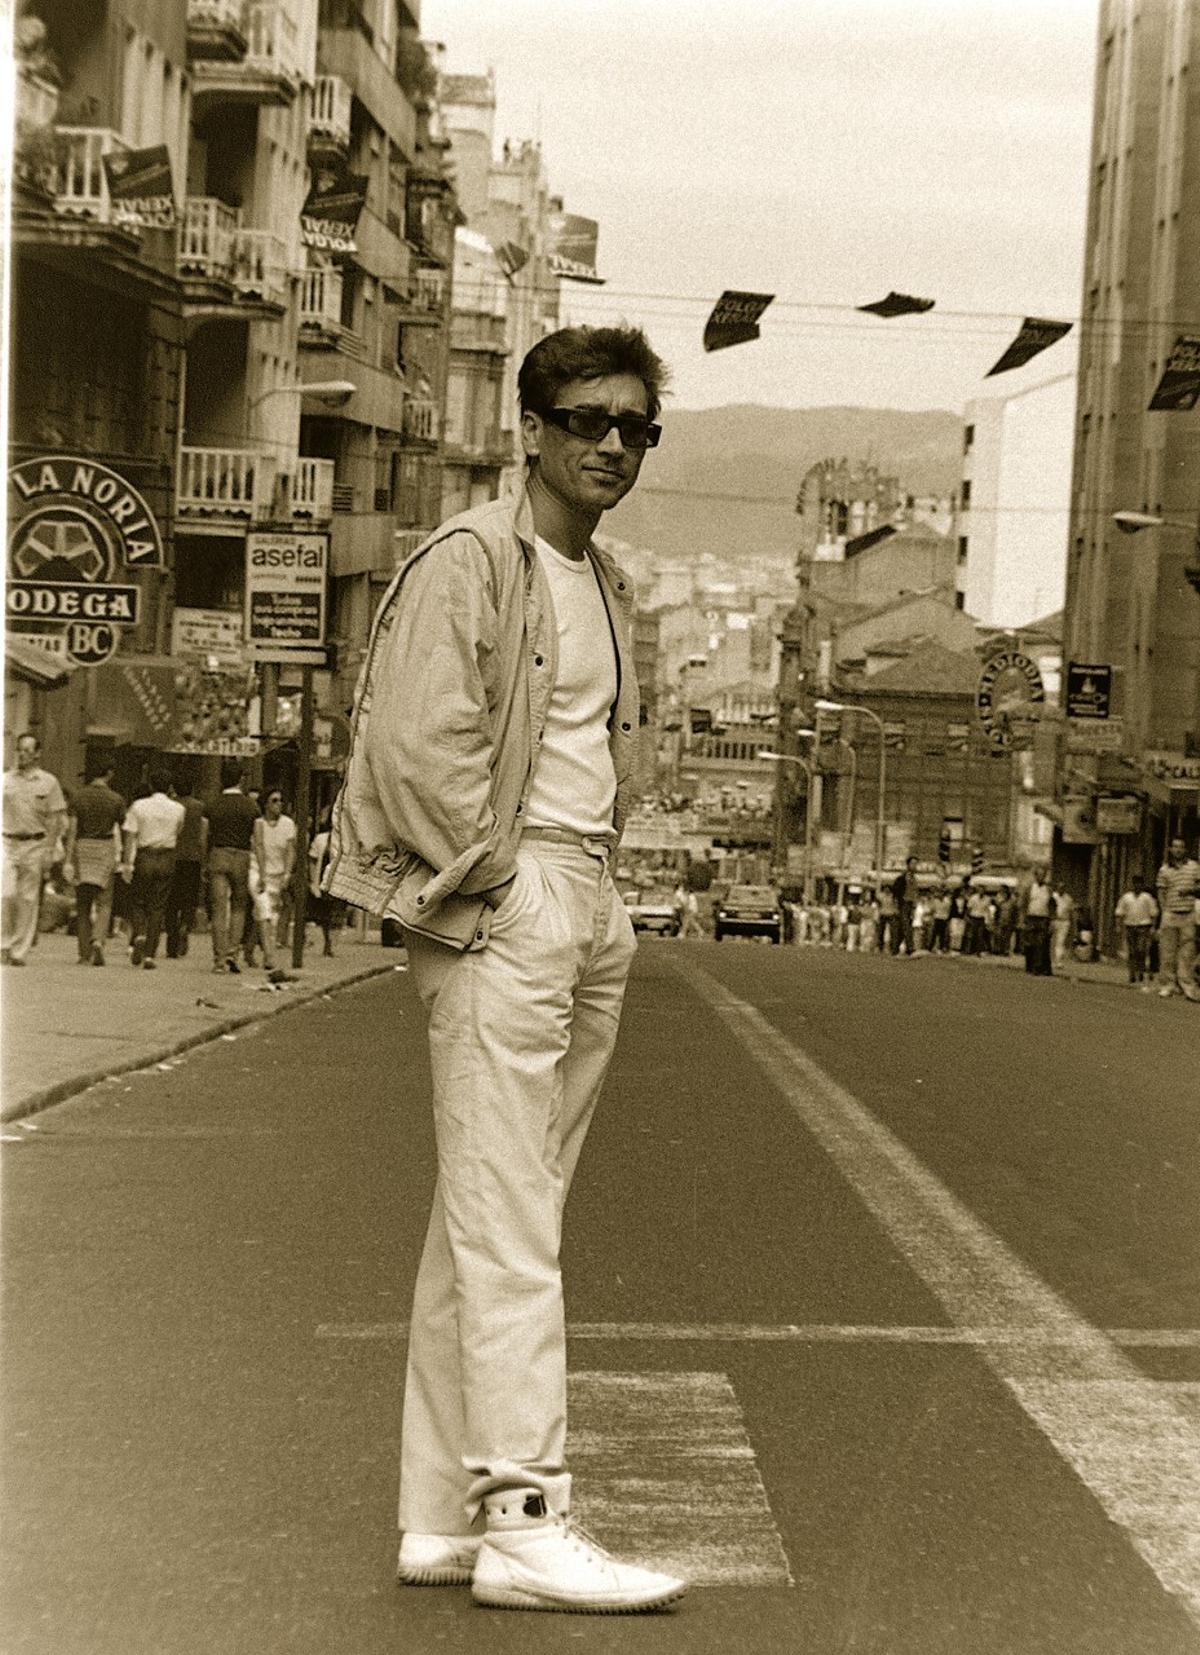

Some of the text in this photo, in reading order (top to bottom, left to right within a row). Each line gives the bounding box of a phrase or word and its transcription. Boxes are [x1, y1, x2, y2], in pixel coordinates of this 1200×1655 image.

[301, 215, 355, 238] XERAL
[12, 464, 155, 562] LA NORIA
[252, 545, 324, 568] asefal
[72, 624, 110, 655] BC
